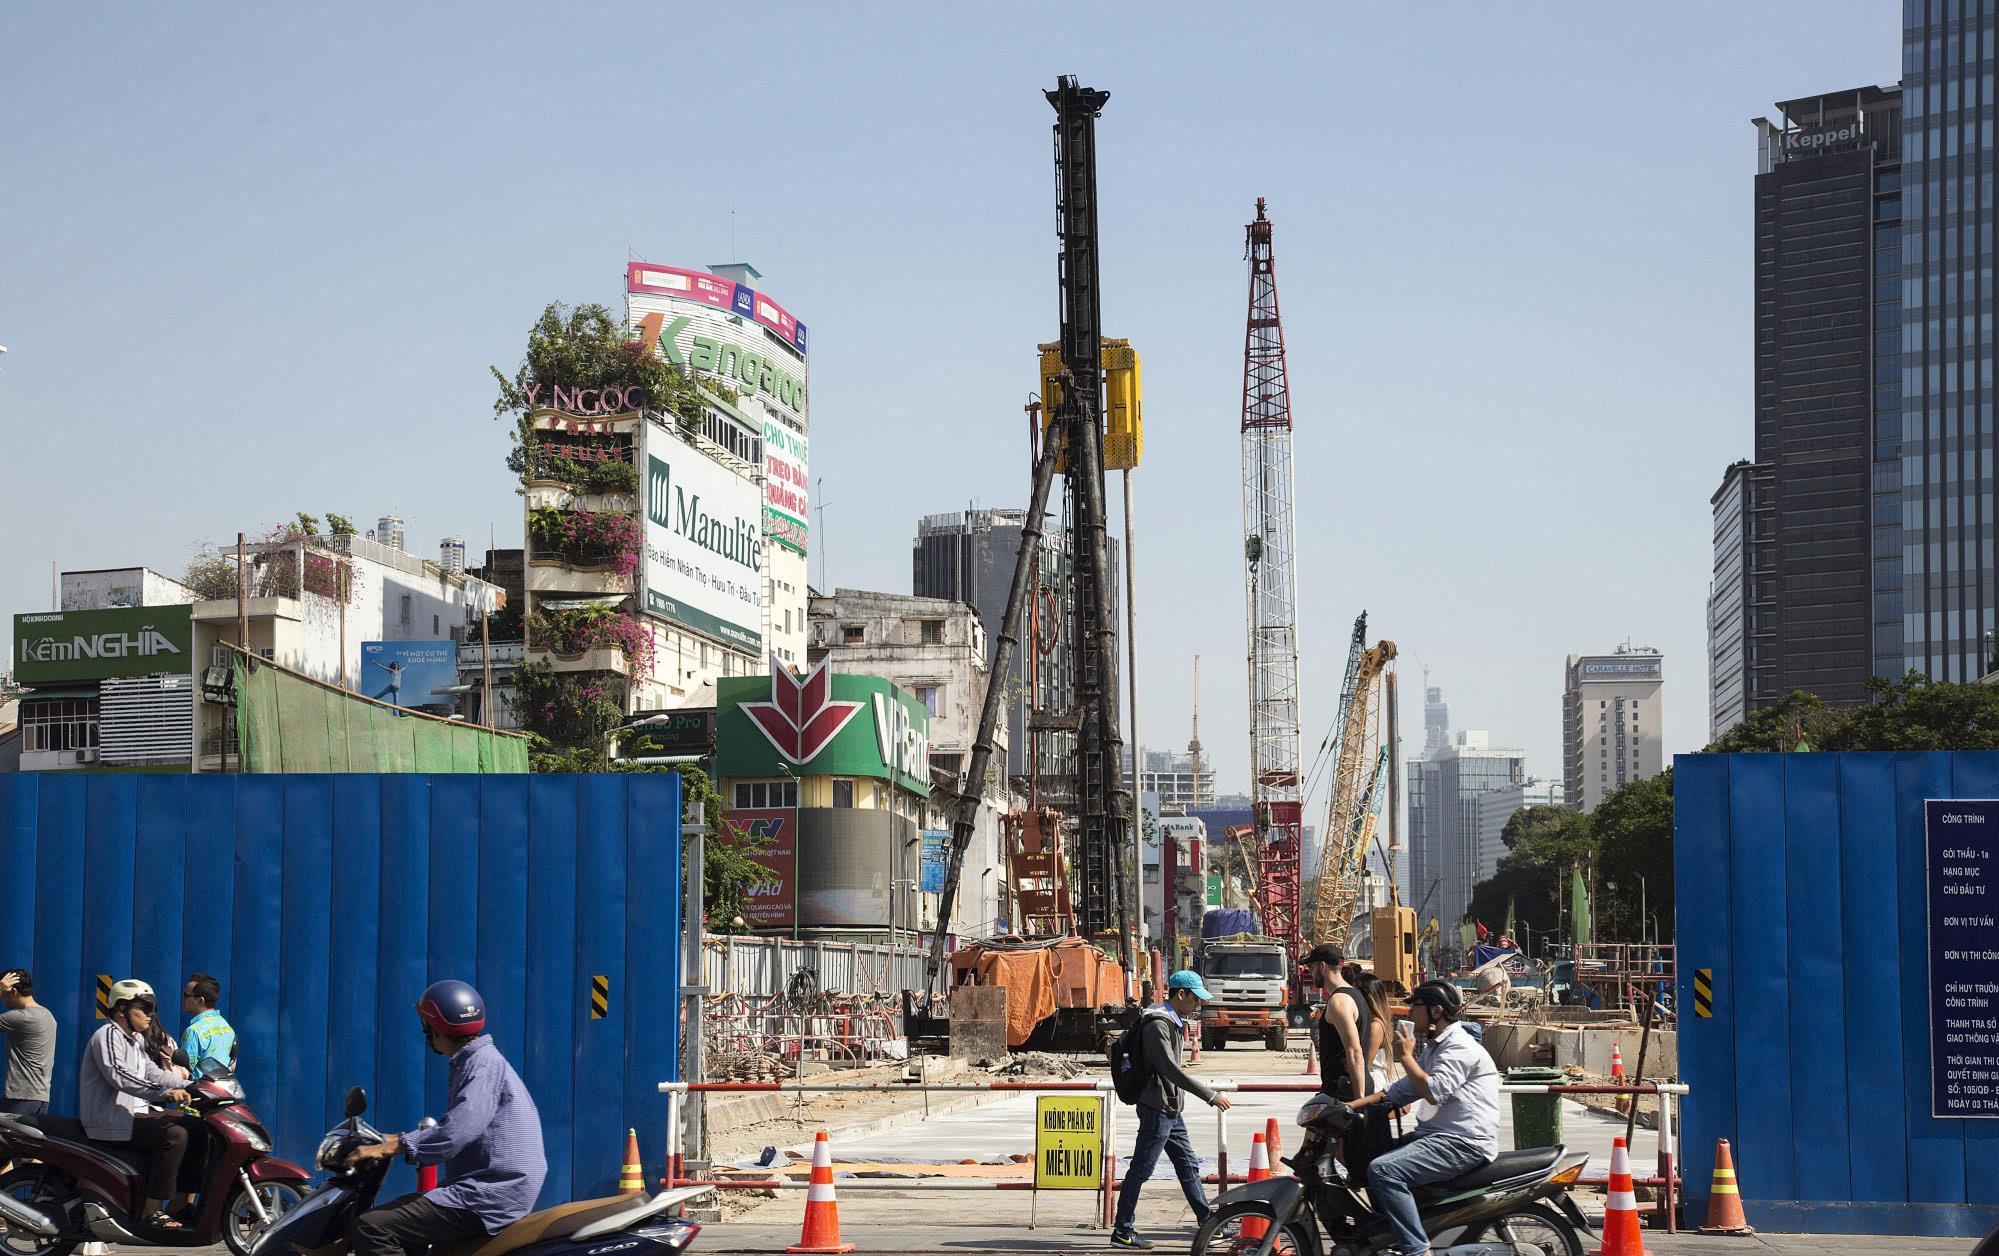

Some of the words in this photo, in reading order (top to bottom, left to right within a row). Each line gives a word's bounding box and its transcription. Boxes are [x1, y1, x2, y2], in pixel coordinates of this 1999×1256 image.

[1786, 123, 1856, 149] Keppel
[635, 312, 806, 413] Kangaroo
[763, 421, 785, 450] CHO
[767, 454, 791, 482] TREO
[674, 484, 761, 573] Manulife
[677, 558, 694, 579] Nhân
[695, 566, 707, 588] Thọ
[1588, 665, 1630, 673] CARAVELLE
[676, 715, 700, 729] Pro
[1942, 812, 1962, 823] CÔNG
[1963, 812, 1985, 823] TRÌNH
[1981, 850, 1989, 859] 1a
[1943, 867, 1963, 877] HẠNG
[1965, 867, 1980, 877] MỤC
[1944, 883, 1958, 894] CHỦ
[1976, 885, 1985, 894] TƯ
[1944, 916, 1959, 926] ĐƠN
[1960, 917, 1967, 928] VỊ
[1969, 916, 1978, 926] TƯ
[1979, 914, 1994, 926] VẤN
[1945, 950, 1960, 960] ĐƠN
[1961, 951, 1967, 962] VỊ
[1969, 951, 1980, 960] THI
[1959, 984, 1973, 993] HUY
[1946, 996, 1966, 1007] CÔNG
[1967, 996, 1988, 1007] TRÌNH
[1946, 1019, 1969, 1028] THANH
[1971, 1019, 1985, 1028] TRA
[1946, 1034, 1963, 1043] GIAO
[1964, 1032, 1989, 1043] THÔNG
[1965, 1056, 1981, 1065] GIAN
[1983, 1057, 1995, 1065] THI
[1947, 1067, 1970, 1079] QUYẾT
[1972, 1071, 1989, 1081] ĐỊNH
[1947, 1082, 1961, 1094] SỐ:
[1963, 1086, 1989, 1094] 105/QĐ
[1948, 1097, 1970, 1108] NGÀY
[1972, 1100, 1981, 1108] 03
[1044, 1107, 1065, 1130] KHÔNG
[1046, 1139, 1071, 1176] MIỄN
[1073, 1144, 1093, 1177] VÀO
[588, 1241, 639, 1255] LEAD
